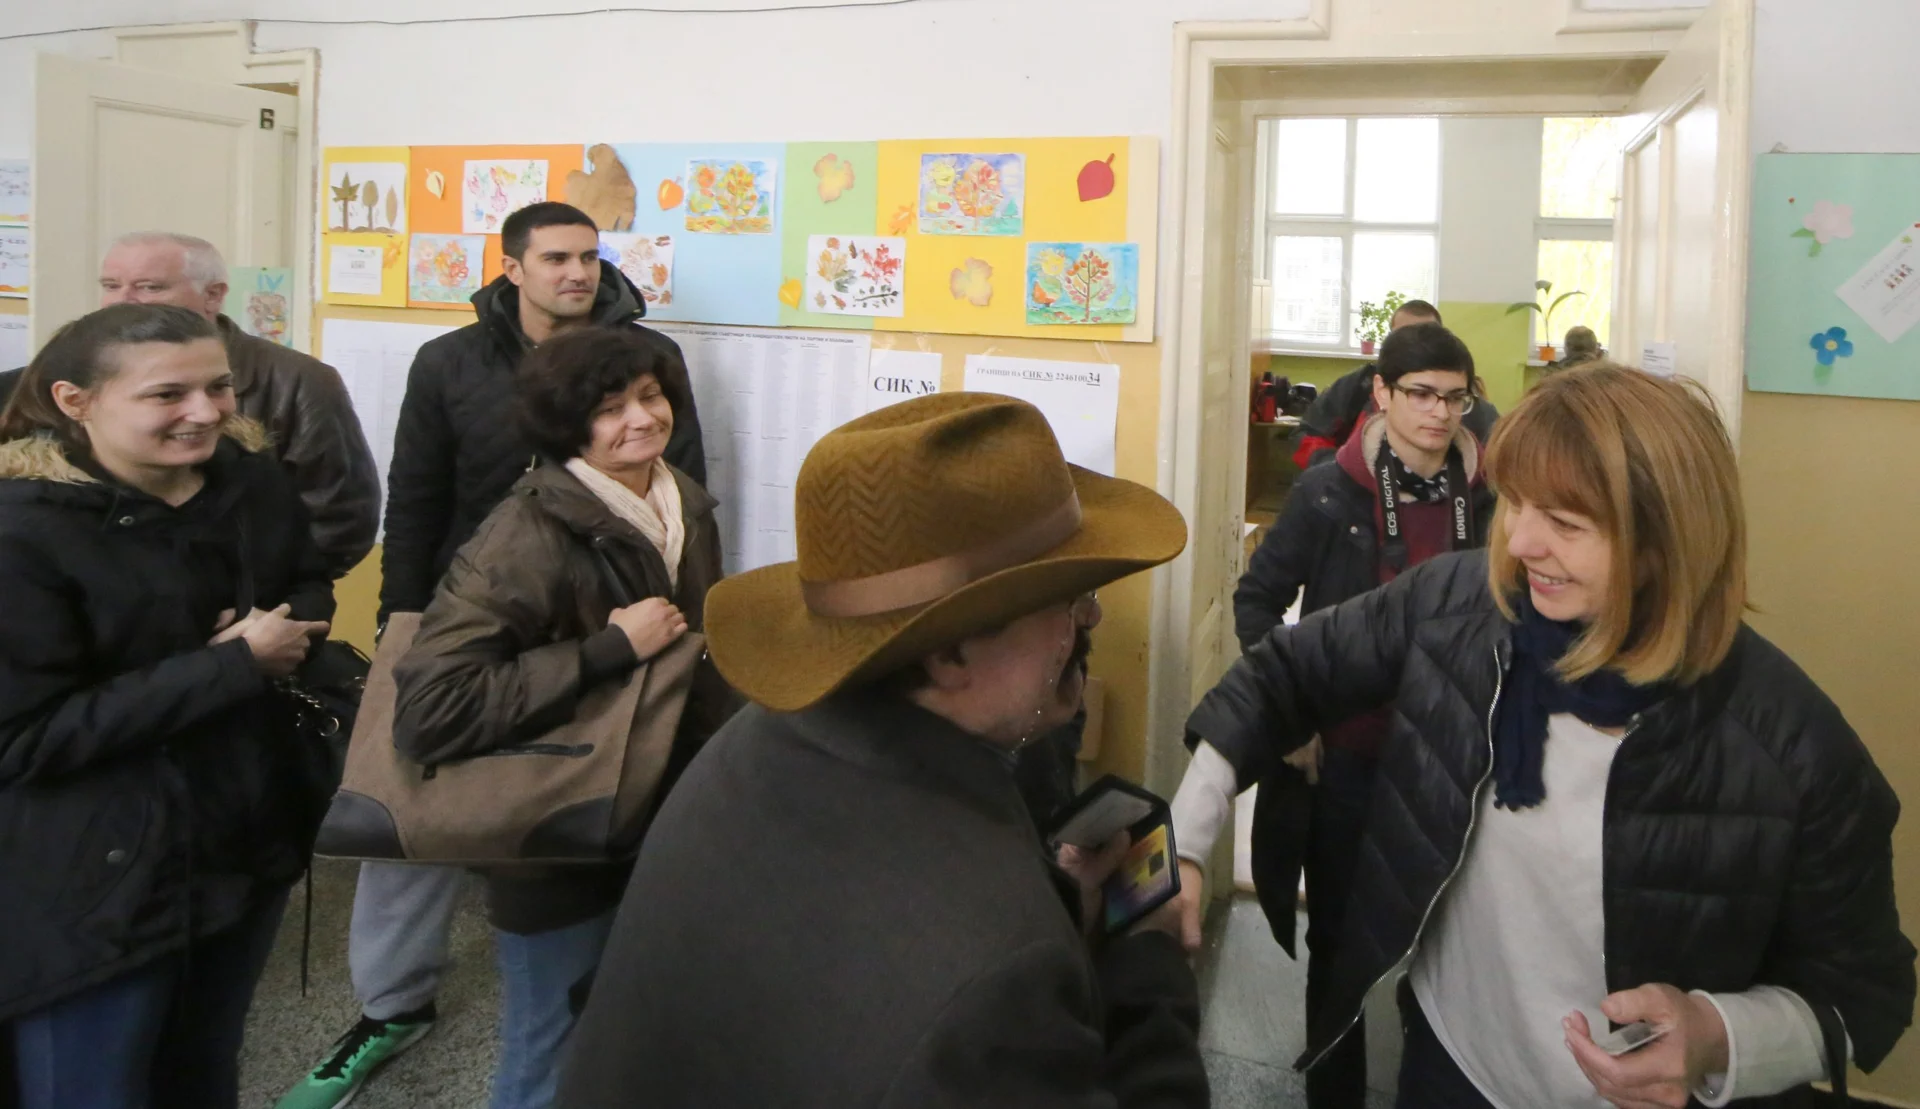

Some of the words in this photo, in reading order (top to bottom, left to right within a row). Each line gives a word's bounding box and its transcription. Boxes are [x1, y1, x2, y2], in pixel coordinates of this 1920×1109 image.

[260, 108, 275, 130] 6
[874, 376, 913, 394] СИК
[1022, 370, 1043, 379] СИК
[1381, 466, 1395, 509] DIGITAL
[1388, 510, 1398, 536] EOS
[1455, 496, 1467, 540] Canon
